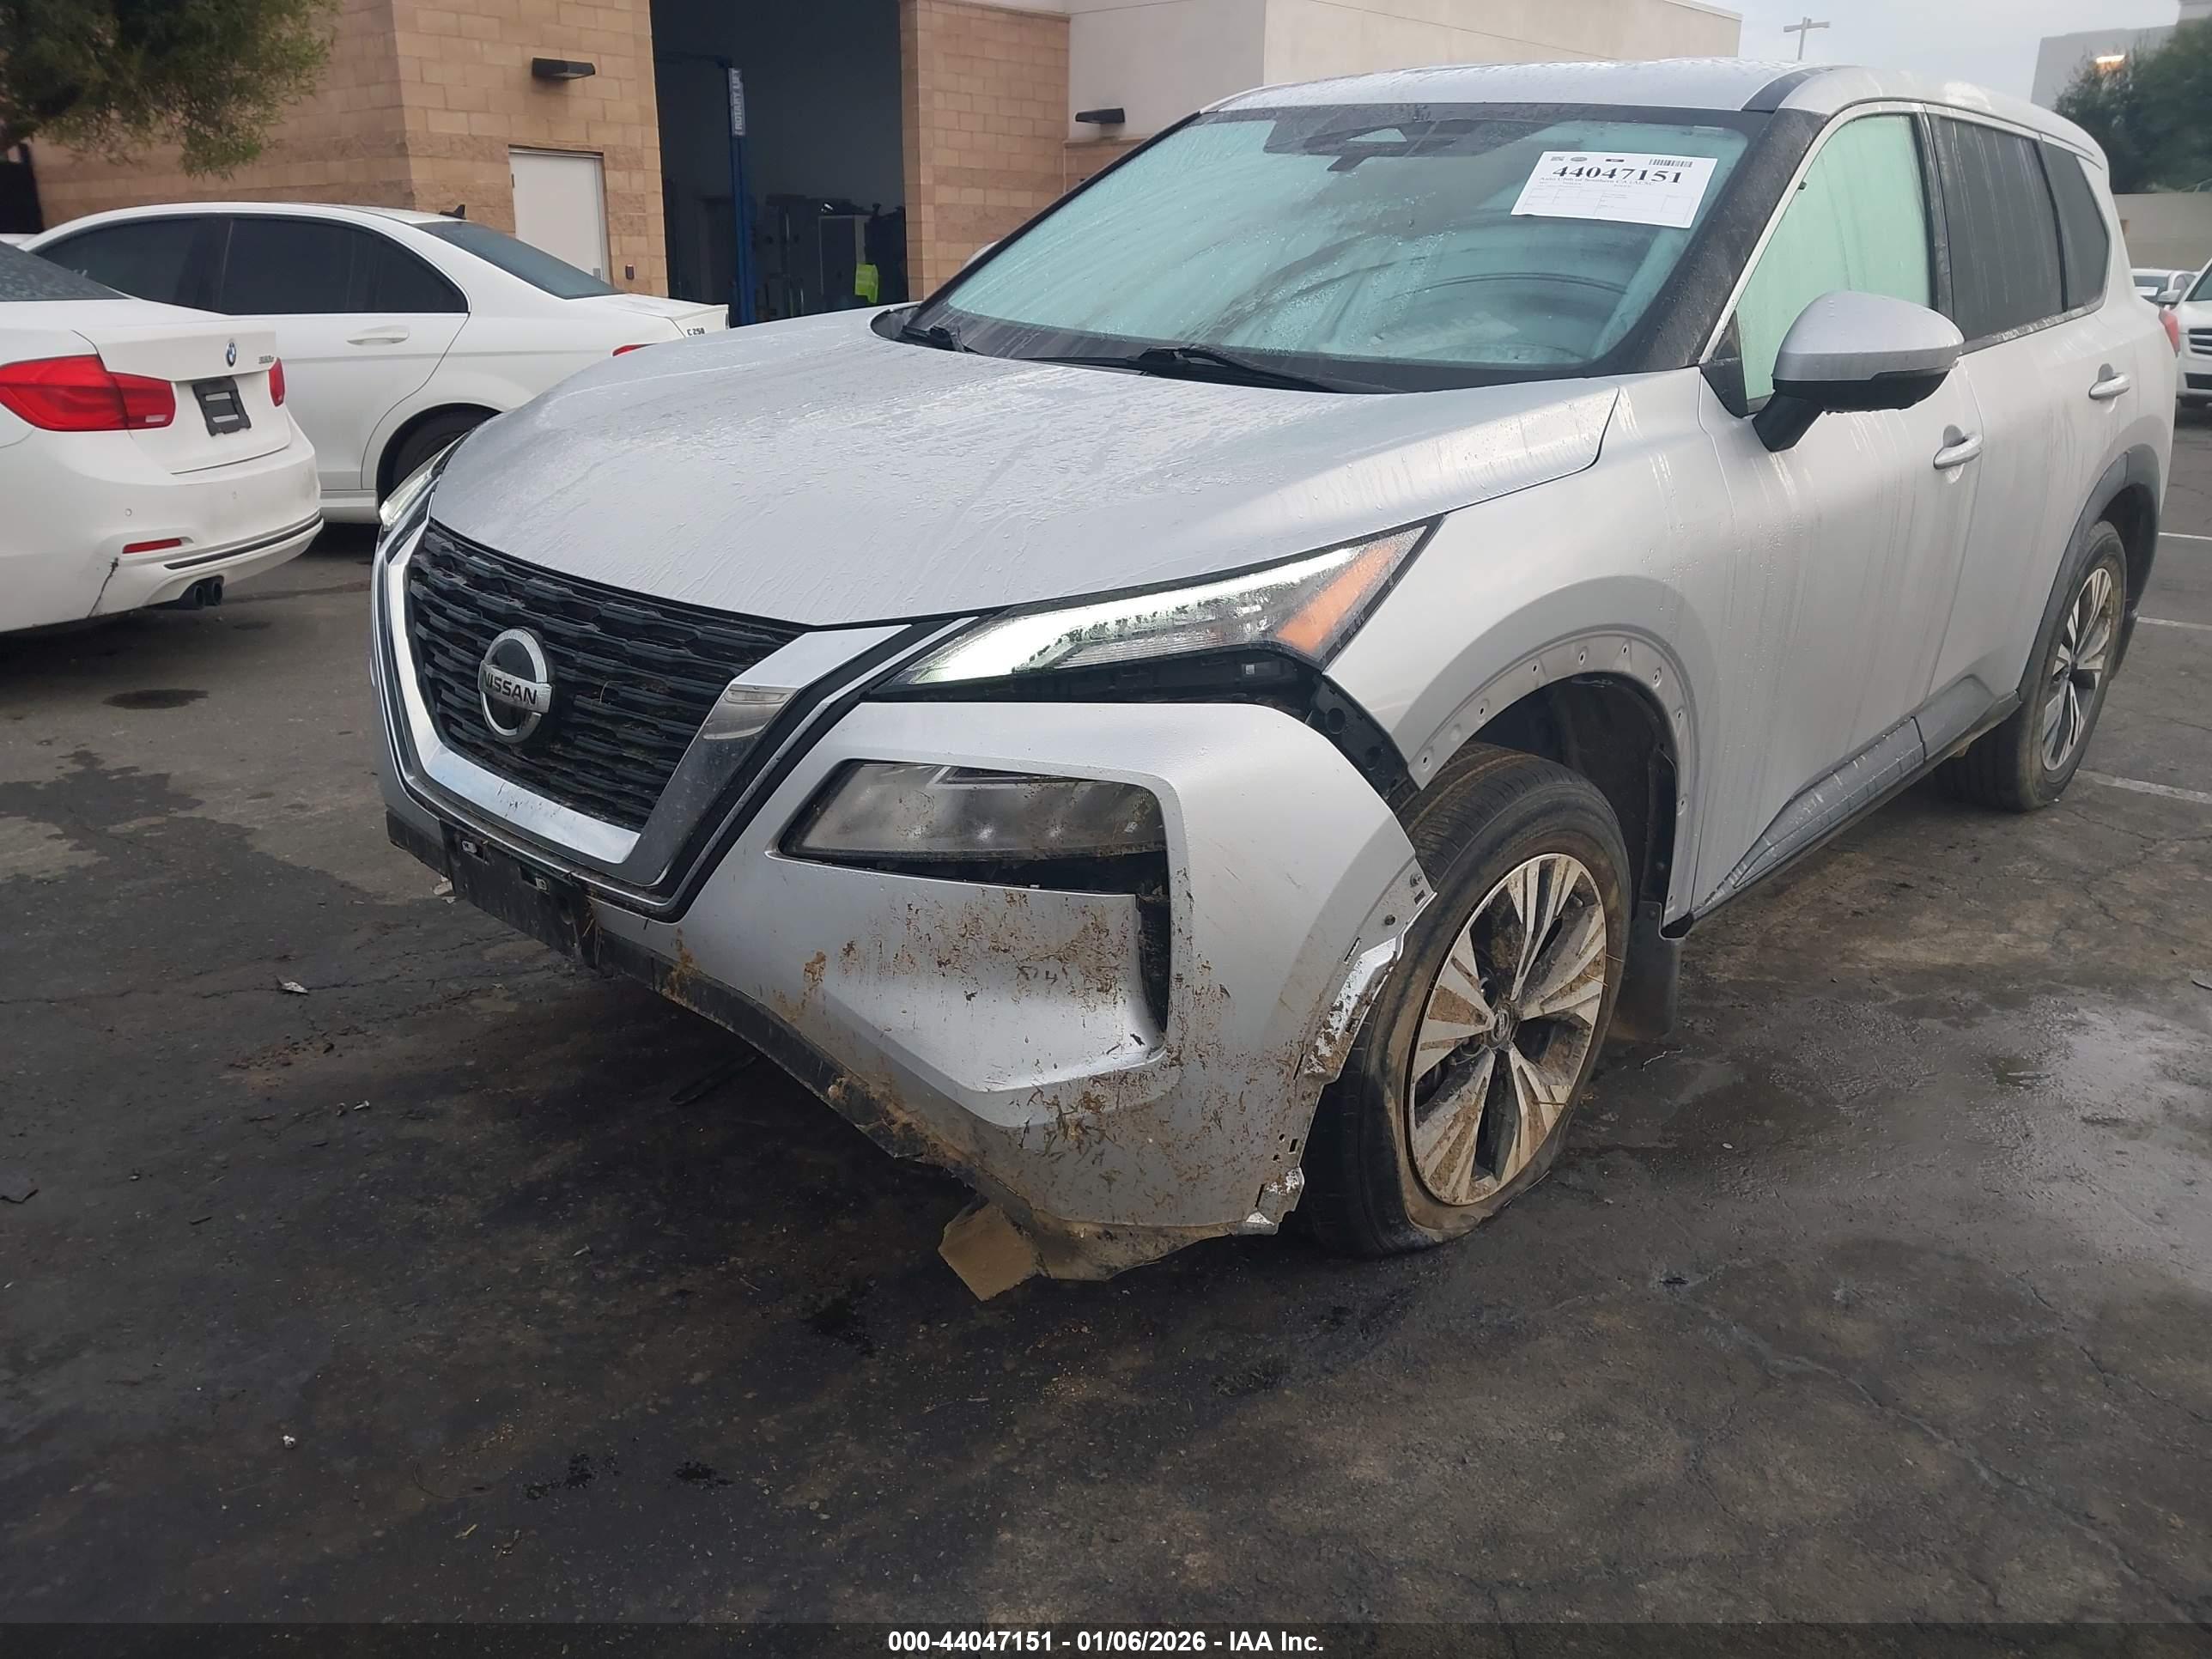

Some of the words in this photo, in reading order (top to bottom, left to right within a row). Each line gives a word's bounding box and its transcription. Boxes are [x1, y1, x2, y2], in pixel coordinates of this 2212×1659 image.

[731, 69, 741, 89] LIFT
[732, 91, 743, 130] ROTARY
[1553, 166, 1682, 183] 44047151
[692, 327, 705, 336] 250
[483, 671, 538, 704] NISSAN
